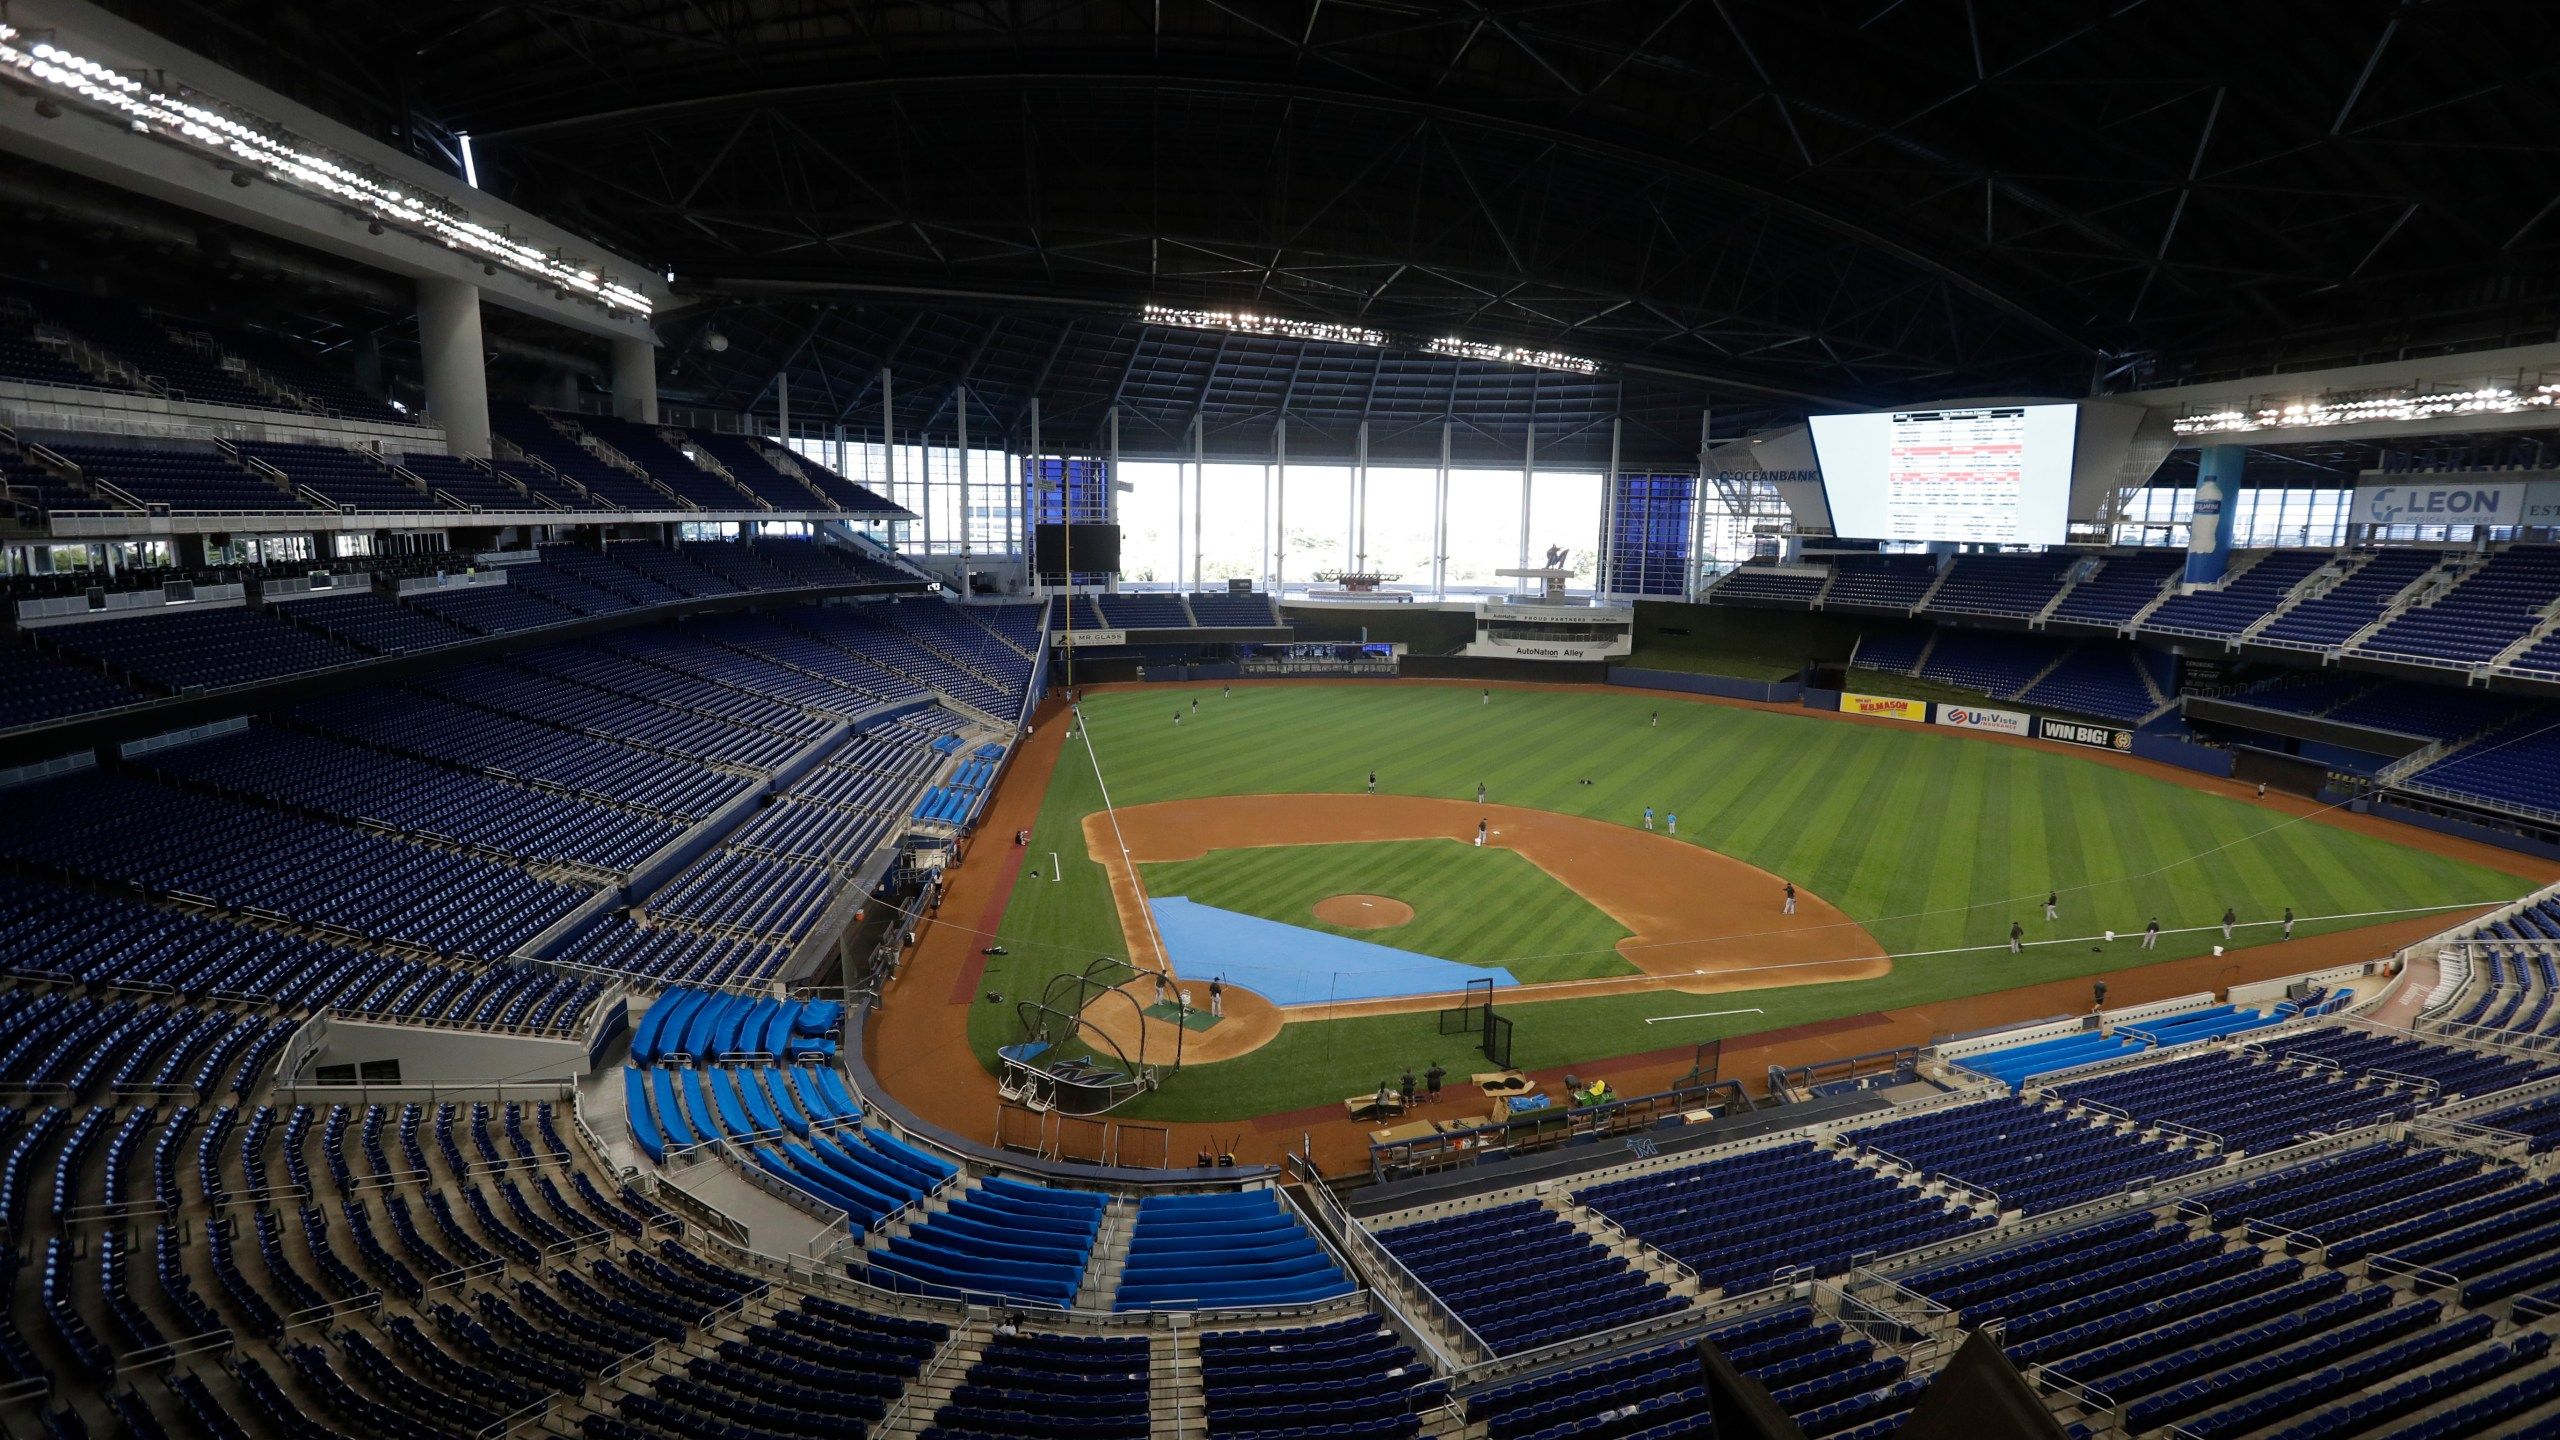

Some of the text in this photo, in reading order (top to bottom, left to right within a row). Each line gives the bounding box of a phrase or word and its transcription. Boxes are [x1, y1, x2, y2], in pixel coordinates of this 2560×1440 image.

[2409, 491, 2499, 513] LEON
[1516, 647, 1584, 658] AutoNation Alley
[2046, 722, 2075, 739] WIN
[2076, 727, 2108, 745] BIG!
